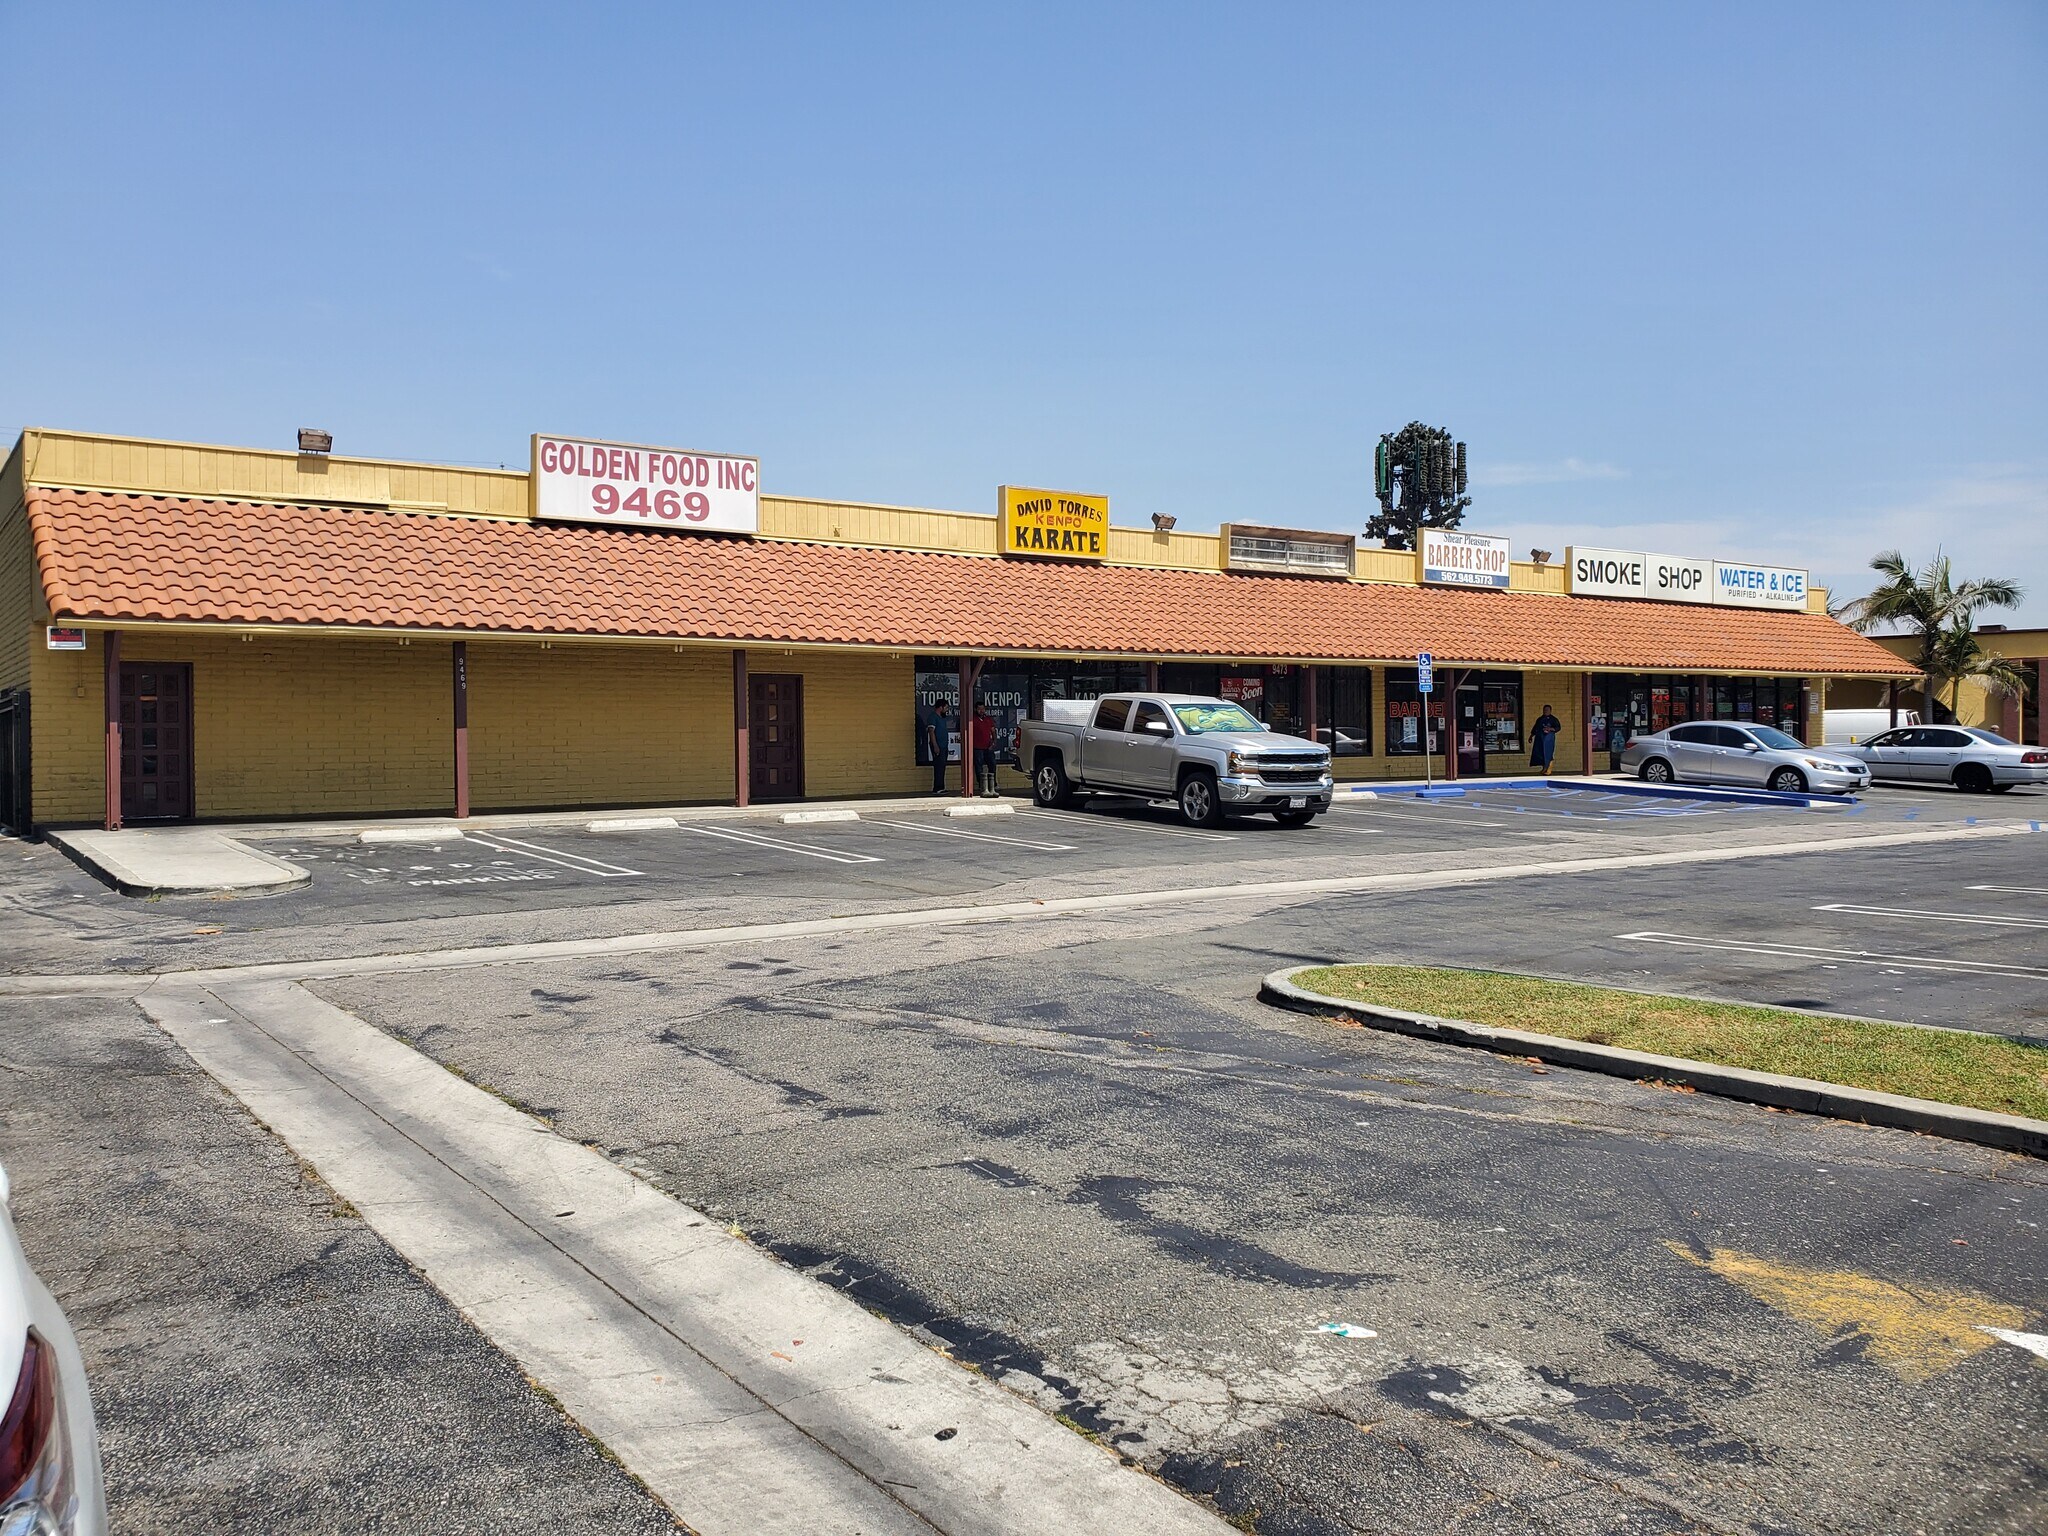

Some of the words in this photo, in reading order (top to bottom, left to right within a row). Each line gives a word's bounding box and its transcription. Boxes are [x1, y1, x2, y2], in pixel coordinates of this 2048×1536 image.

[541, 441, 640, 482] GOLDEN
[648, 453, 710, 488] FOOD
[717, 460, 755, 492] INC
[591, 483, 710, 522] 9469
[1016, 498, 1052, 517] DAVID
[1058, 499, 1103, 523] TORRES
[1035, 513, 1082, 528] KENPO
[1015, 525, 1100, 553] KARATE
[1443, 532, 1462, 544] Shear
[1464, 534, 1491, 547] Pleasure
[1428, 543, 1472, 569] BARBER
[1476, 548, 1506, 572] SHOP
[1441, 571, 1493, 585] 562.948.5773
[1577, 558, 1642, 586] SMOKE
[1658, 565, 1702, 590] SHOP
[1719, 567, 1765, 590] WATER
[1770, 573, 1778, 591] &
[1782, 574, 1803, 593] ICE
[1728, 589, 1757, 599] PURIFIED
[1766, 592, 1794, 602] ALKALINE
[458, 657, 467, 690] 9469
[1272, 664, 1288, 675] 9473
[984, 691, 1021, 707] KENPO
[1241, 686, 1263, 701] Soon
[408, 874, 557, 887] PARKING
